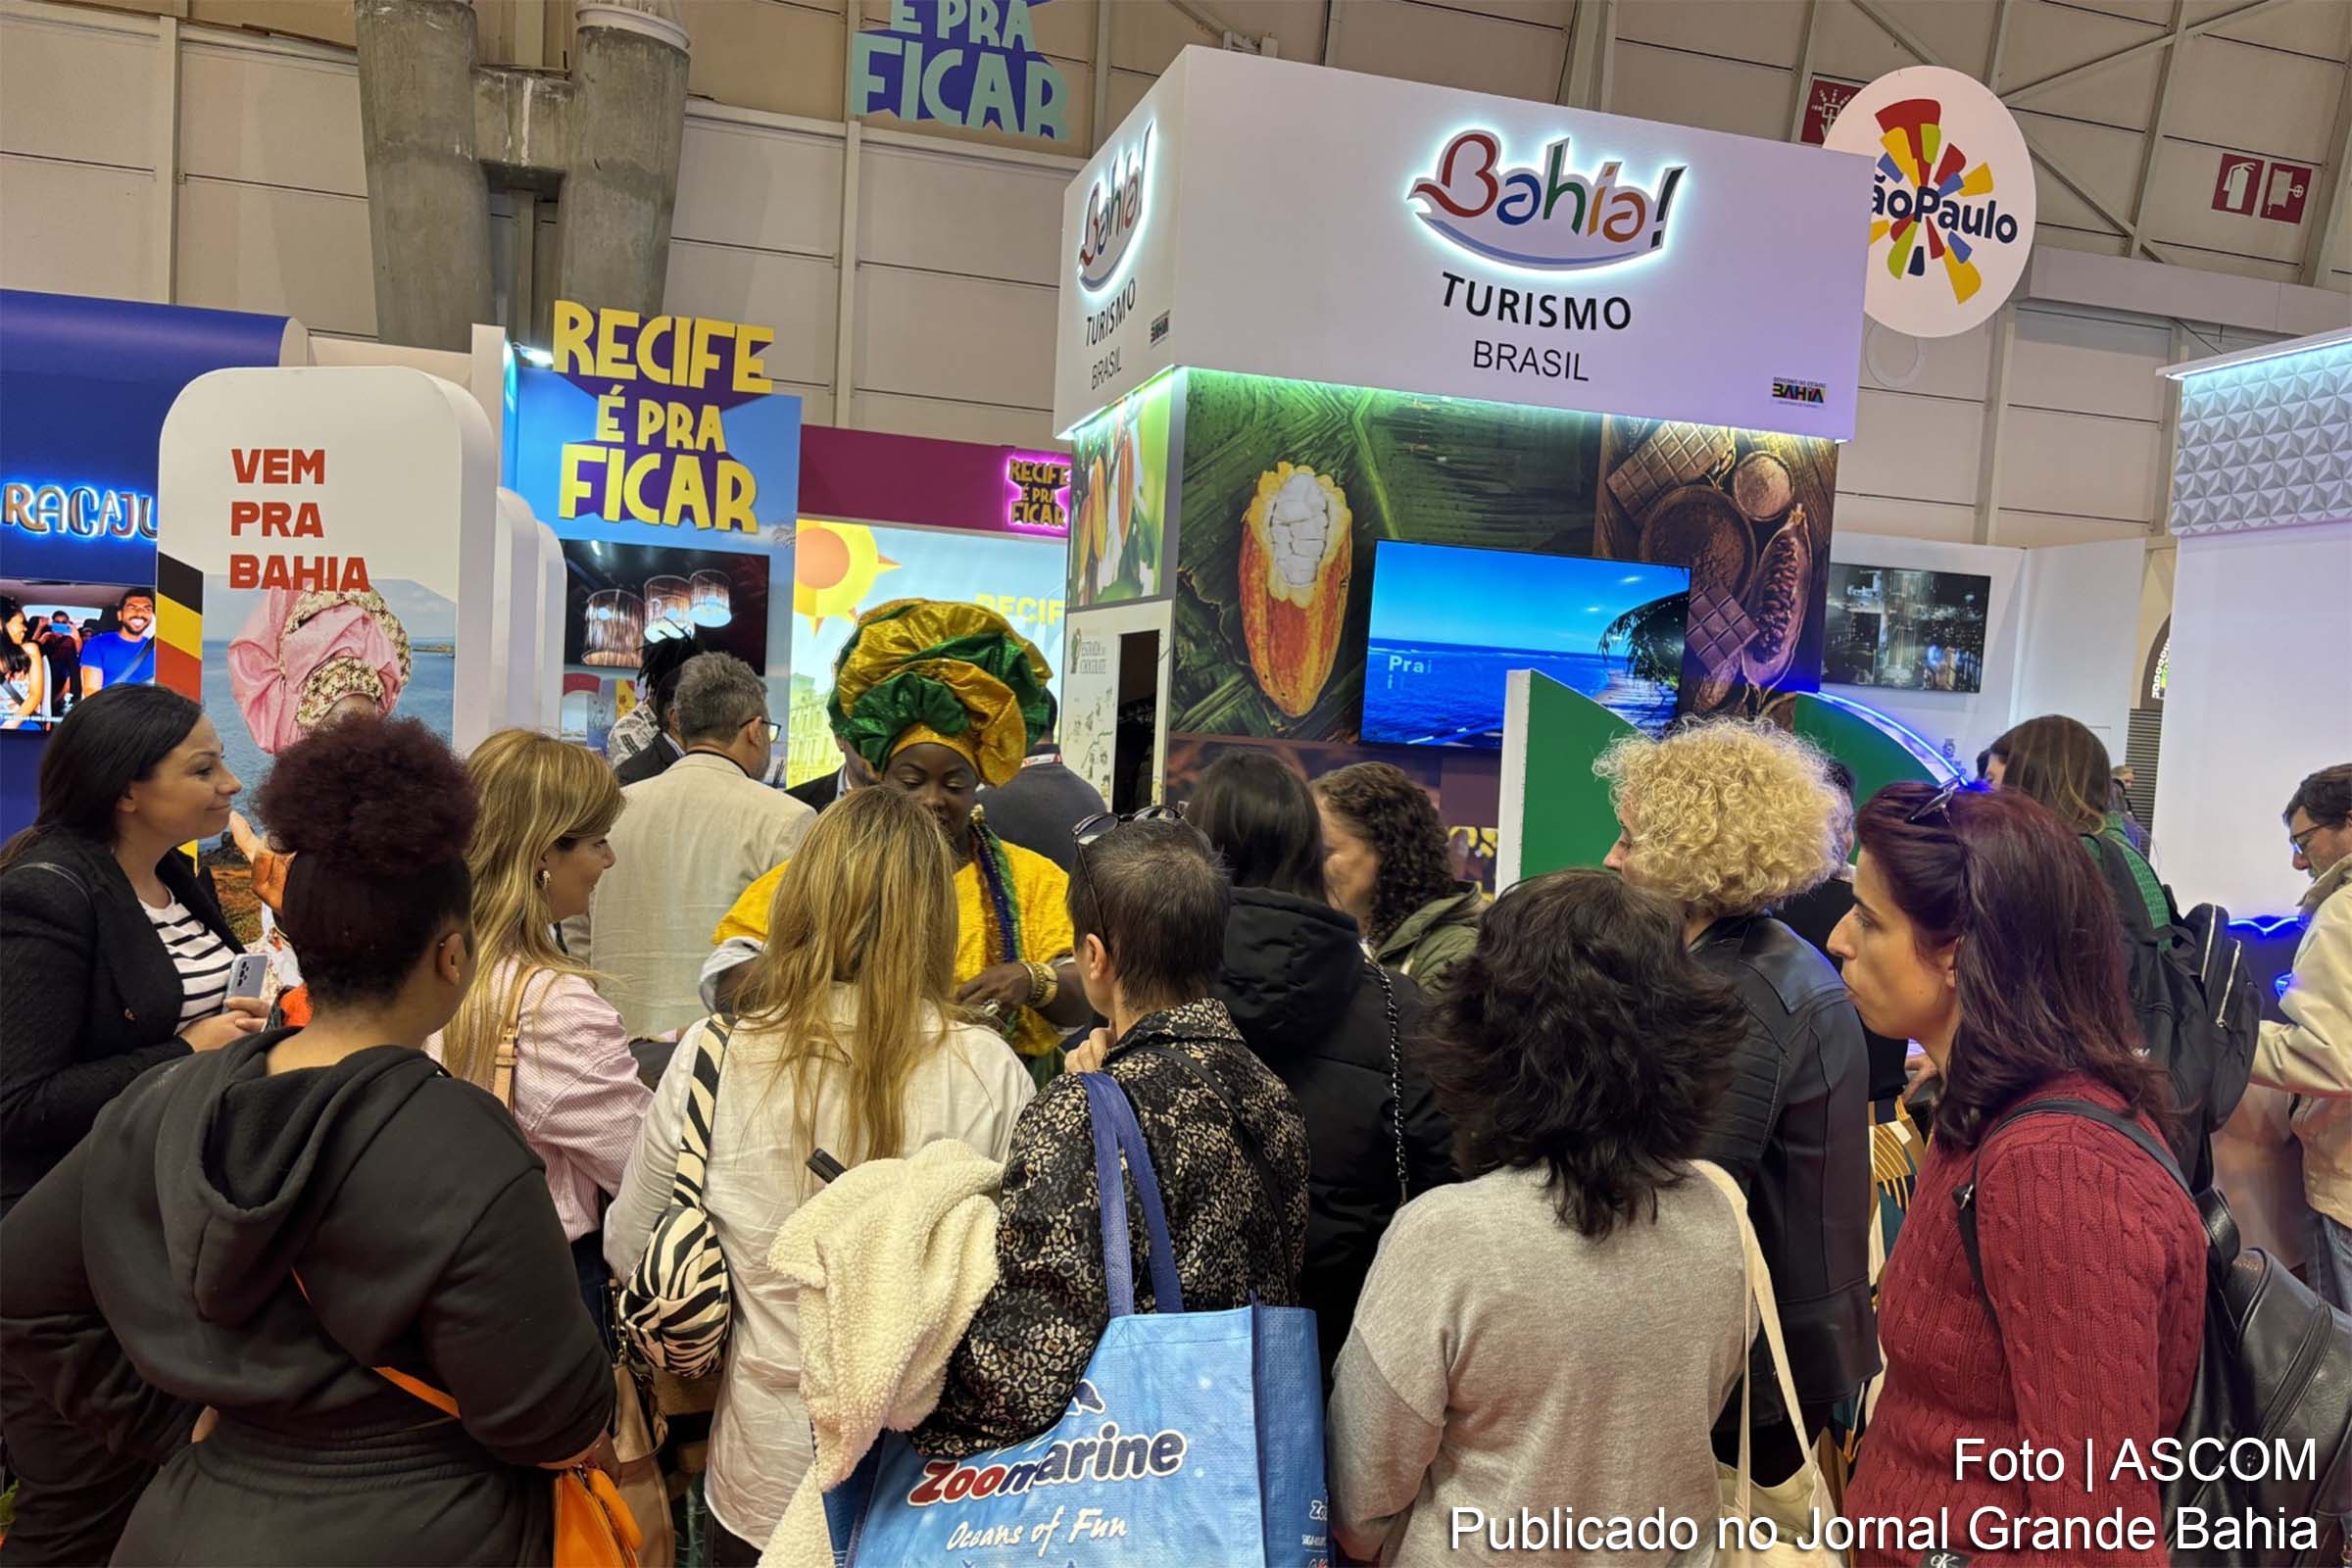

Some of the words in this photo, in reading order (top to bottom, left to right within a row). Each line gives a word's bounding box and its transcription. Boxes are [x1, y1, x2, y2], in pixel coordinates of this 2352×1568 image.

[937, 0, 1036, 52] PRA
[851, 32, 1071, 142] FICAR
[1086, 277, 1136, 347] TURISMO
[1442, 270, 1632, 331] TURISMO
[553, 300, 774, 394] RECIFE
[1091, 346, 1122, 391] BRASIL
[1473, 340, 1590, 382] BRASIL
[596, 384, 625, 443] É
[638, 399, 727, 454] PRA
[231, 449, 325, 484] VEM
[559, 443, 759, 534] FICAR
[1009, 460, 1070, 486] RECIFE
[231, 501, 324, 538] PRA
[1010, 502, 1064, 527] FICAR
[229, 554, 370, 593] BAHIA
[907, 1421, 1188, 1505] Zoomarine
[947, 1521, 1023, 1551] Oceans
[1032, 1505, 1064, 1557] of
[1068, 1508, 1127, 1544] Fun
